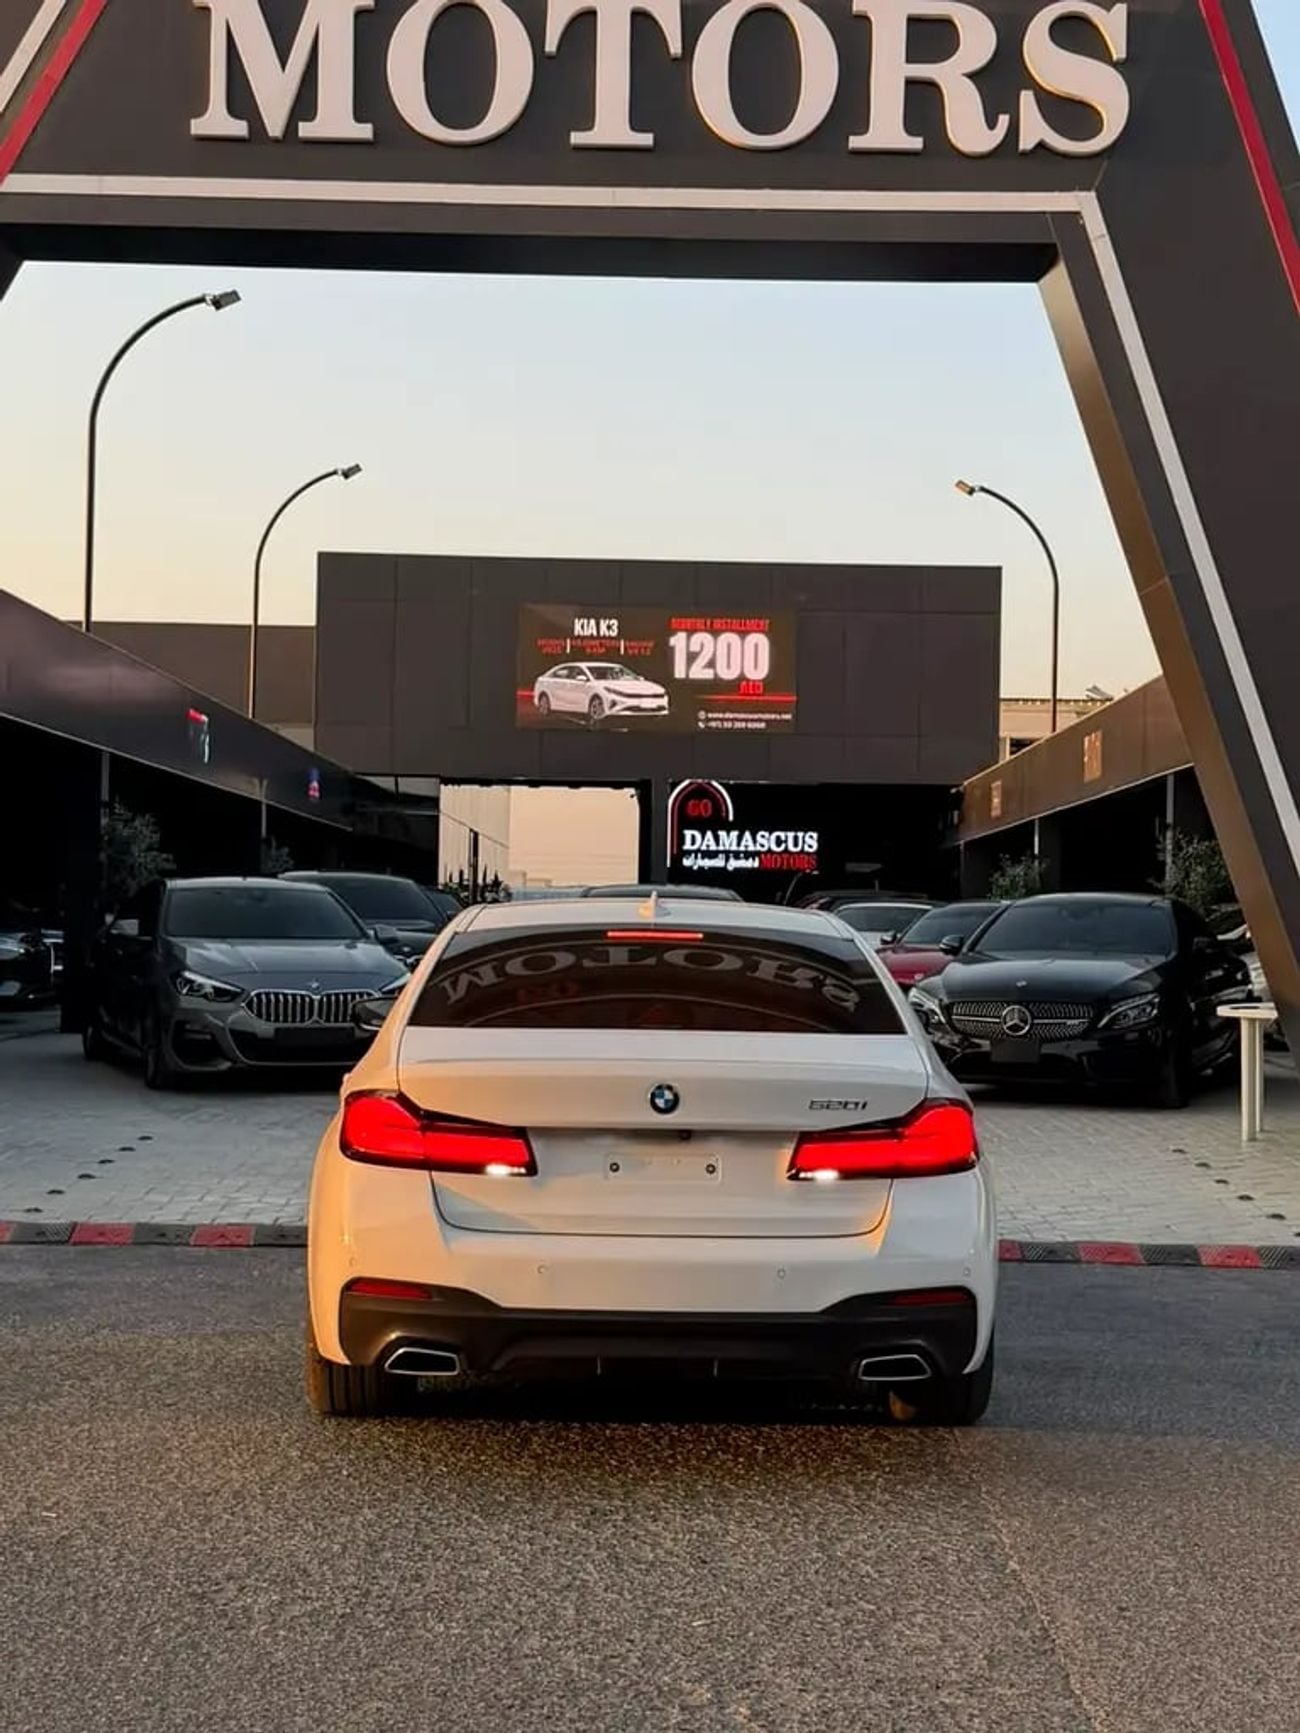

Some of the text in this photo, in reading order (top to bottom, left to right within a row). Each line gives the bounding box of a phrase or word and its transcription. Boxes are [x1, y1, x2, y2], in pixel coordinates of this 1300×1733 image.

[190, 0, 1131, 156] MOTORS
[574, 618, 618, 637] KIA K3
[669, 631, 770, 680] 1200
[682, 829, 819, 852] DAMASCUS
[760, 853, 817, 871] MOTORS
